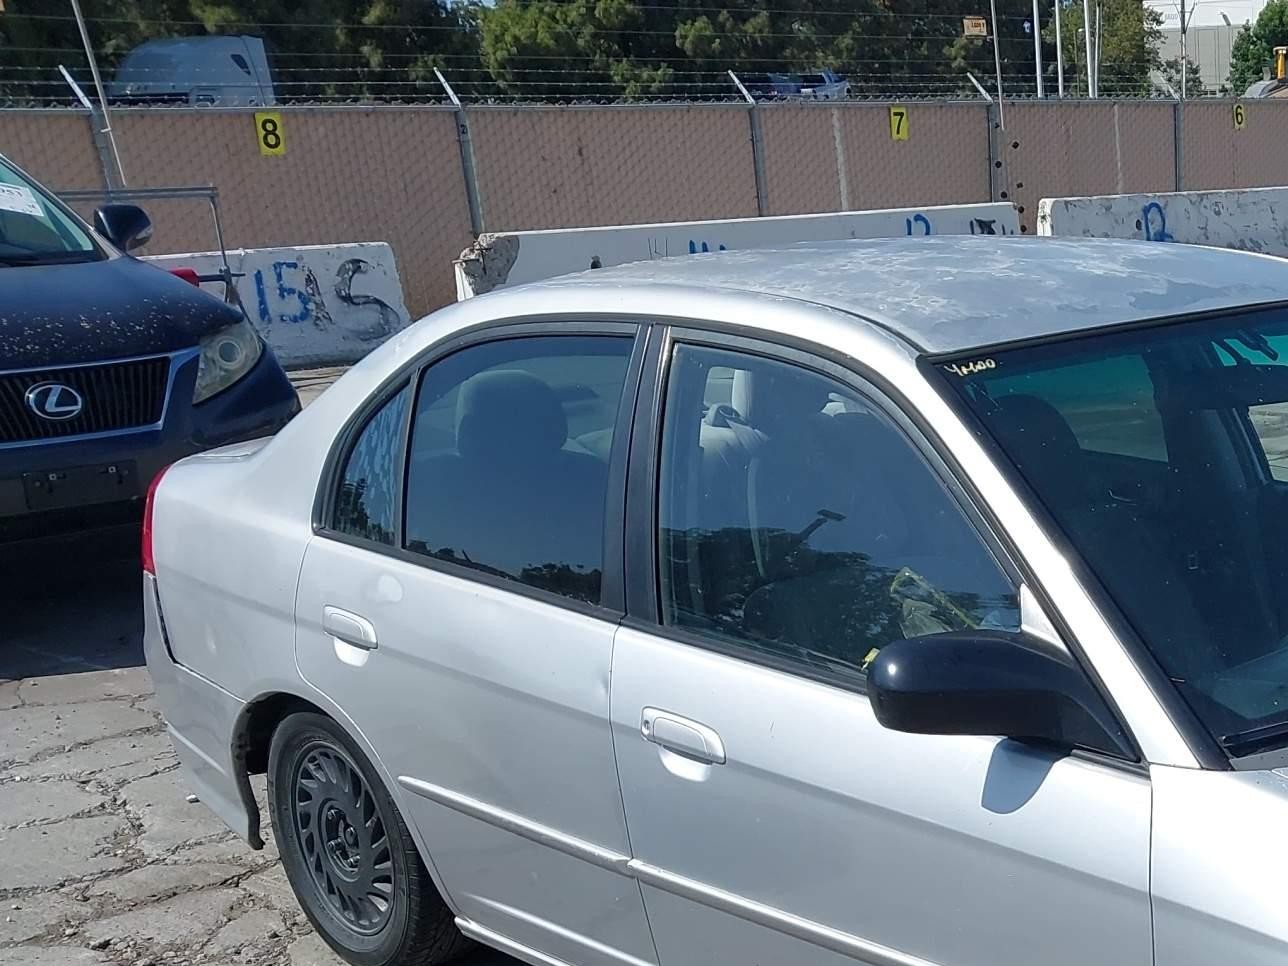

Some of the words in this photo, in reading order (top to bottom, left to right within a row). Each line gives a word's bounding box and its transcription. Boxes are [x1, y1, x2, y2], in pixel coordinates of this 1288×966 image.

[893, 112, 904, 135] 7
[1235, 105, 1243, 125] 6
[261, 118, 281, 149] 8
[255, 261, 311, 323] 15
